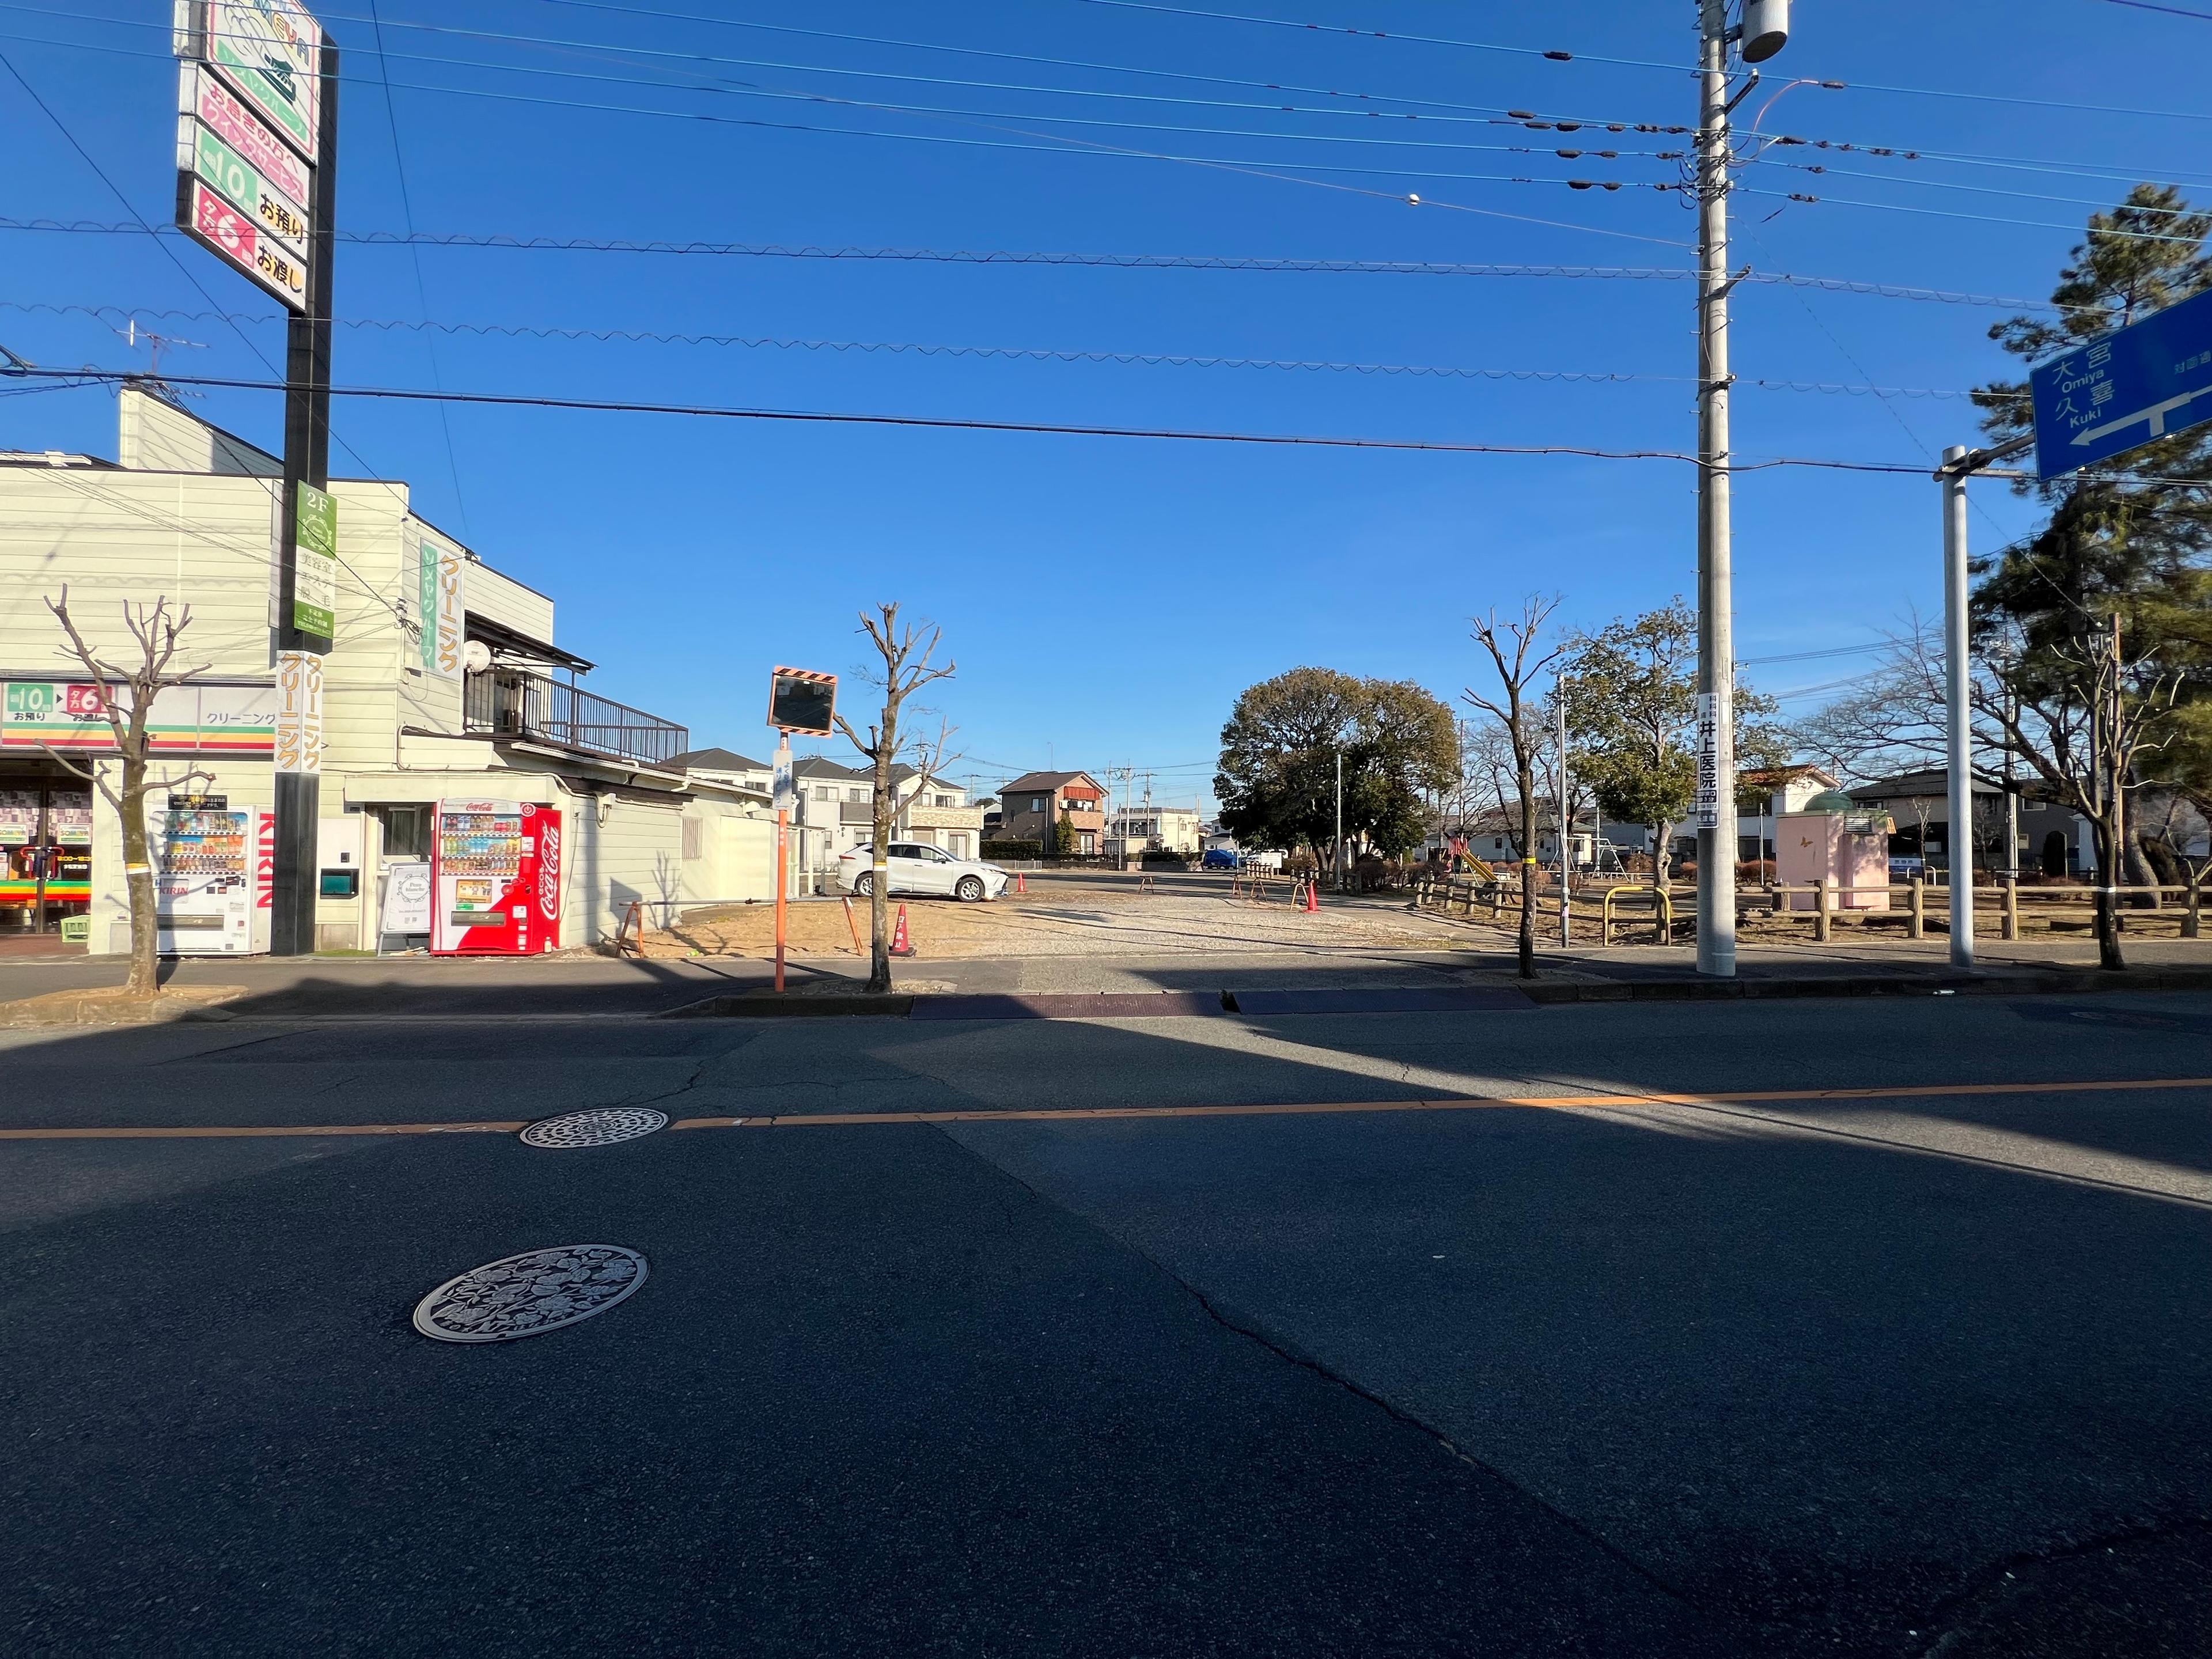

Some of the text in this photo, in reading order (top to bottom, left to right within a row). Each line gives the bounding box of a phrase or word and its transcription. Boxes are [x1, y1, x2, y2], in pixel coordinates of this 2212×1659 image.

[260, 193, 303, 244] お預り
[257, 245, 302, 293] お渡し
[2052, 342, 2111, 384] 大宮
[2061, 369, 2104, 393] Omiya
[2055, 379, 2115, 421] 久喜
[2070, 407, 2101, 428] Kuki
[307, 492, 328, 513] 2F
[438, 555, 459, 673] クリーニング
[14, 713, 45, 721] お預り
[207, 713, 276, 725] クリーニング
[277, 653, 301, 769] クリーニング
[304, 655, 321, 770] クリーニング
[1700, 720, 1716, 789] 井上医院
[257, 813, 275, 908] KIRIN
